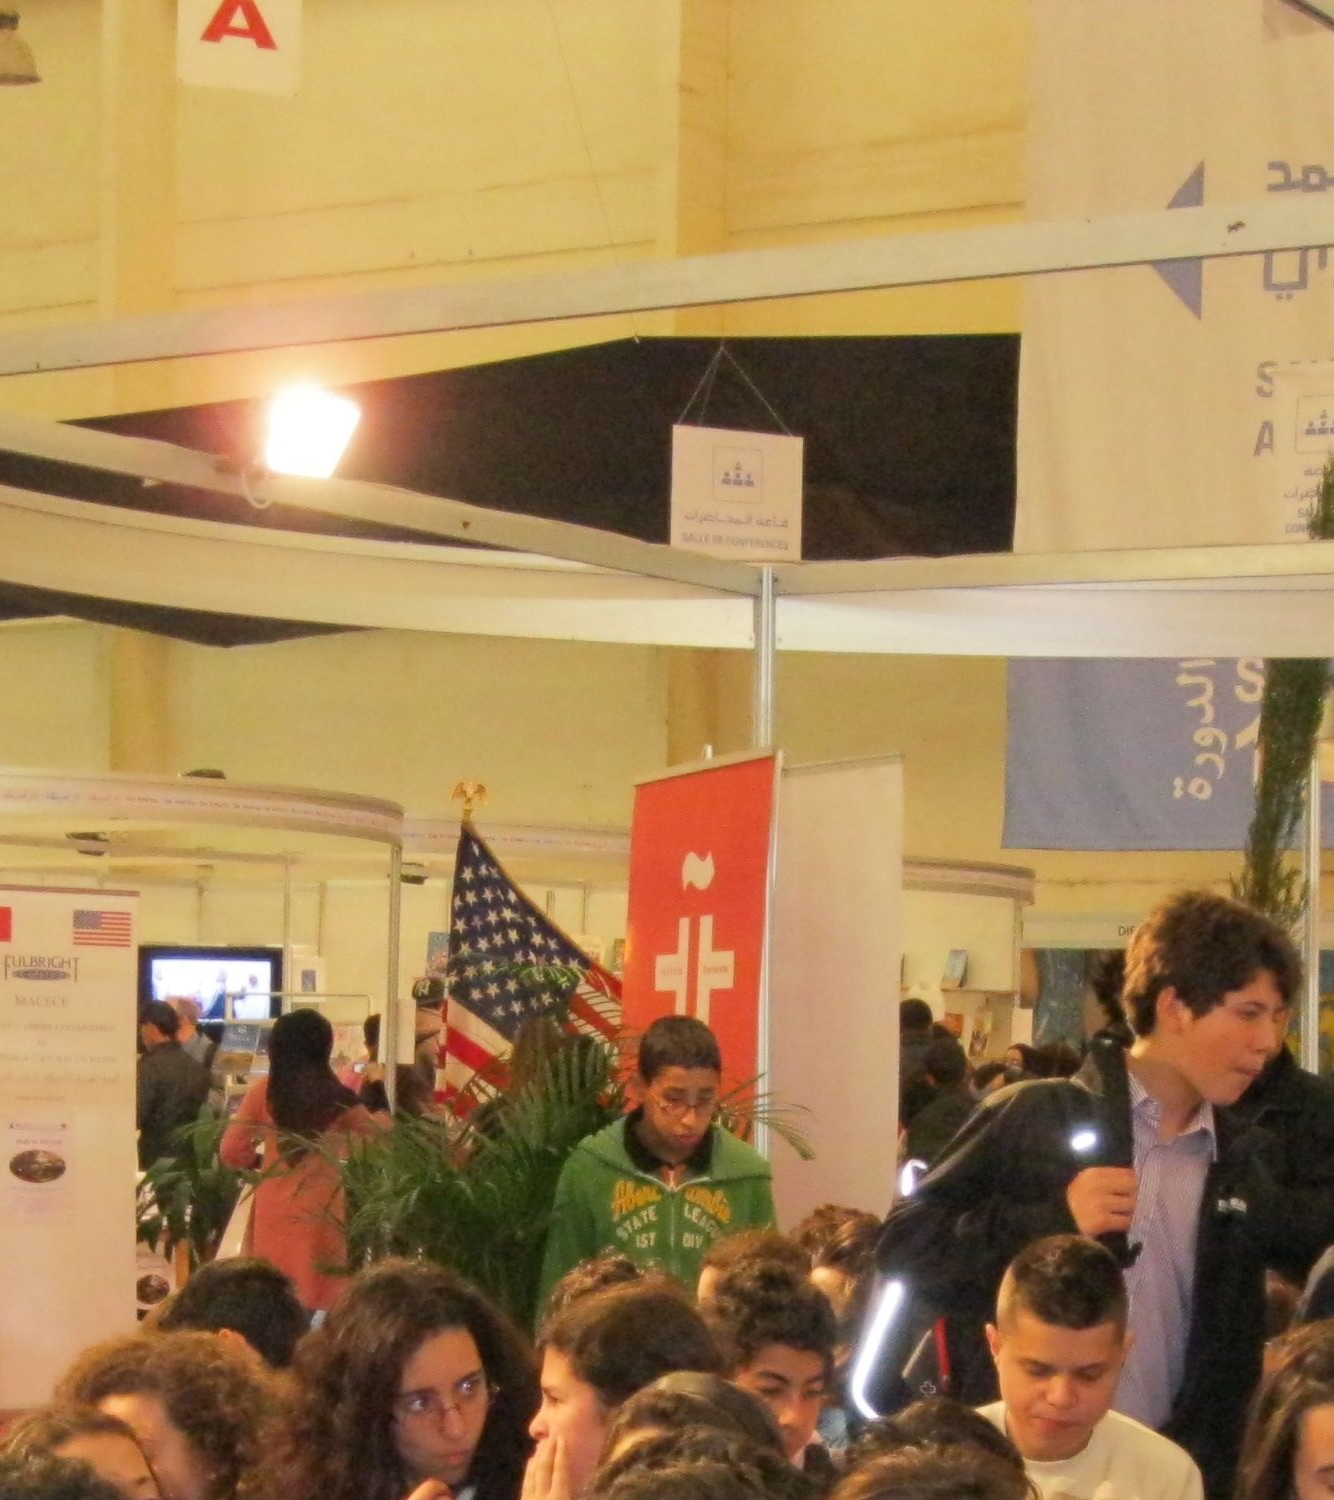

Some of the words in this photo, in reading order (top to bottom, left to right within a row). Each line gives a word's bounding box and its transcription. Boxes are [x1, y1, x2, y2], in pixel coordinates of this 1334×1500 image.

[200, 0, 278, 50] A
[4, 955, 81, 983] FULBRIGHT
[616, 1205, 658, 1241] STATE
